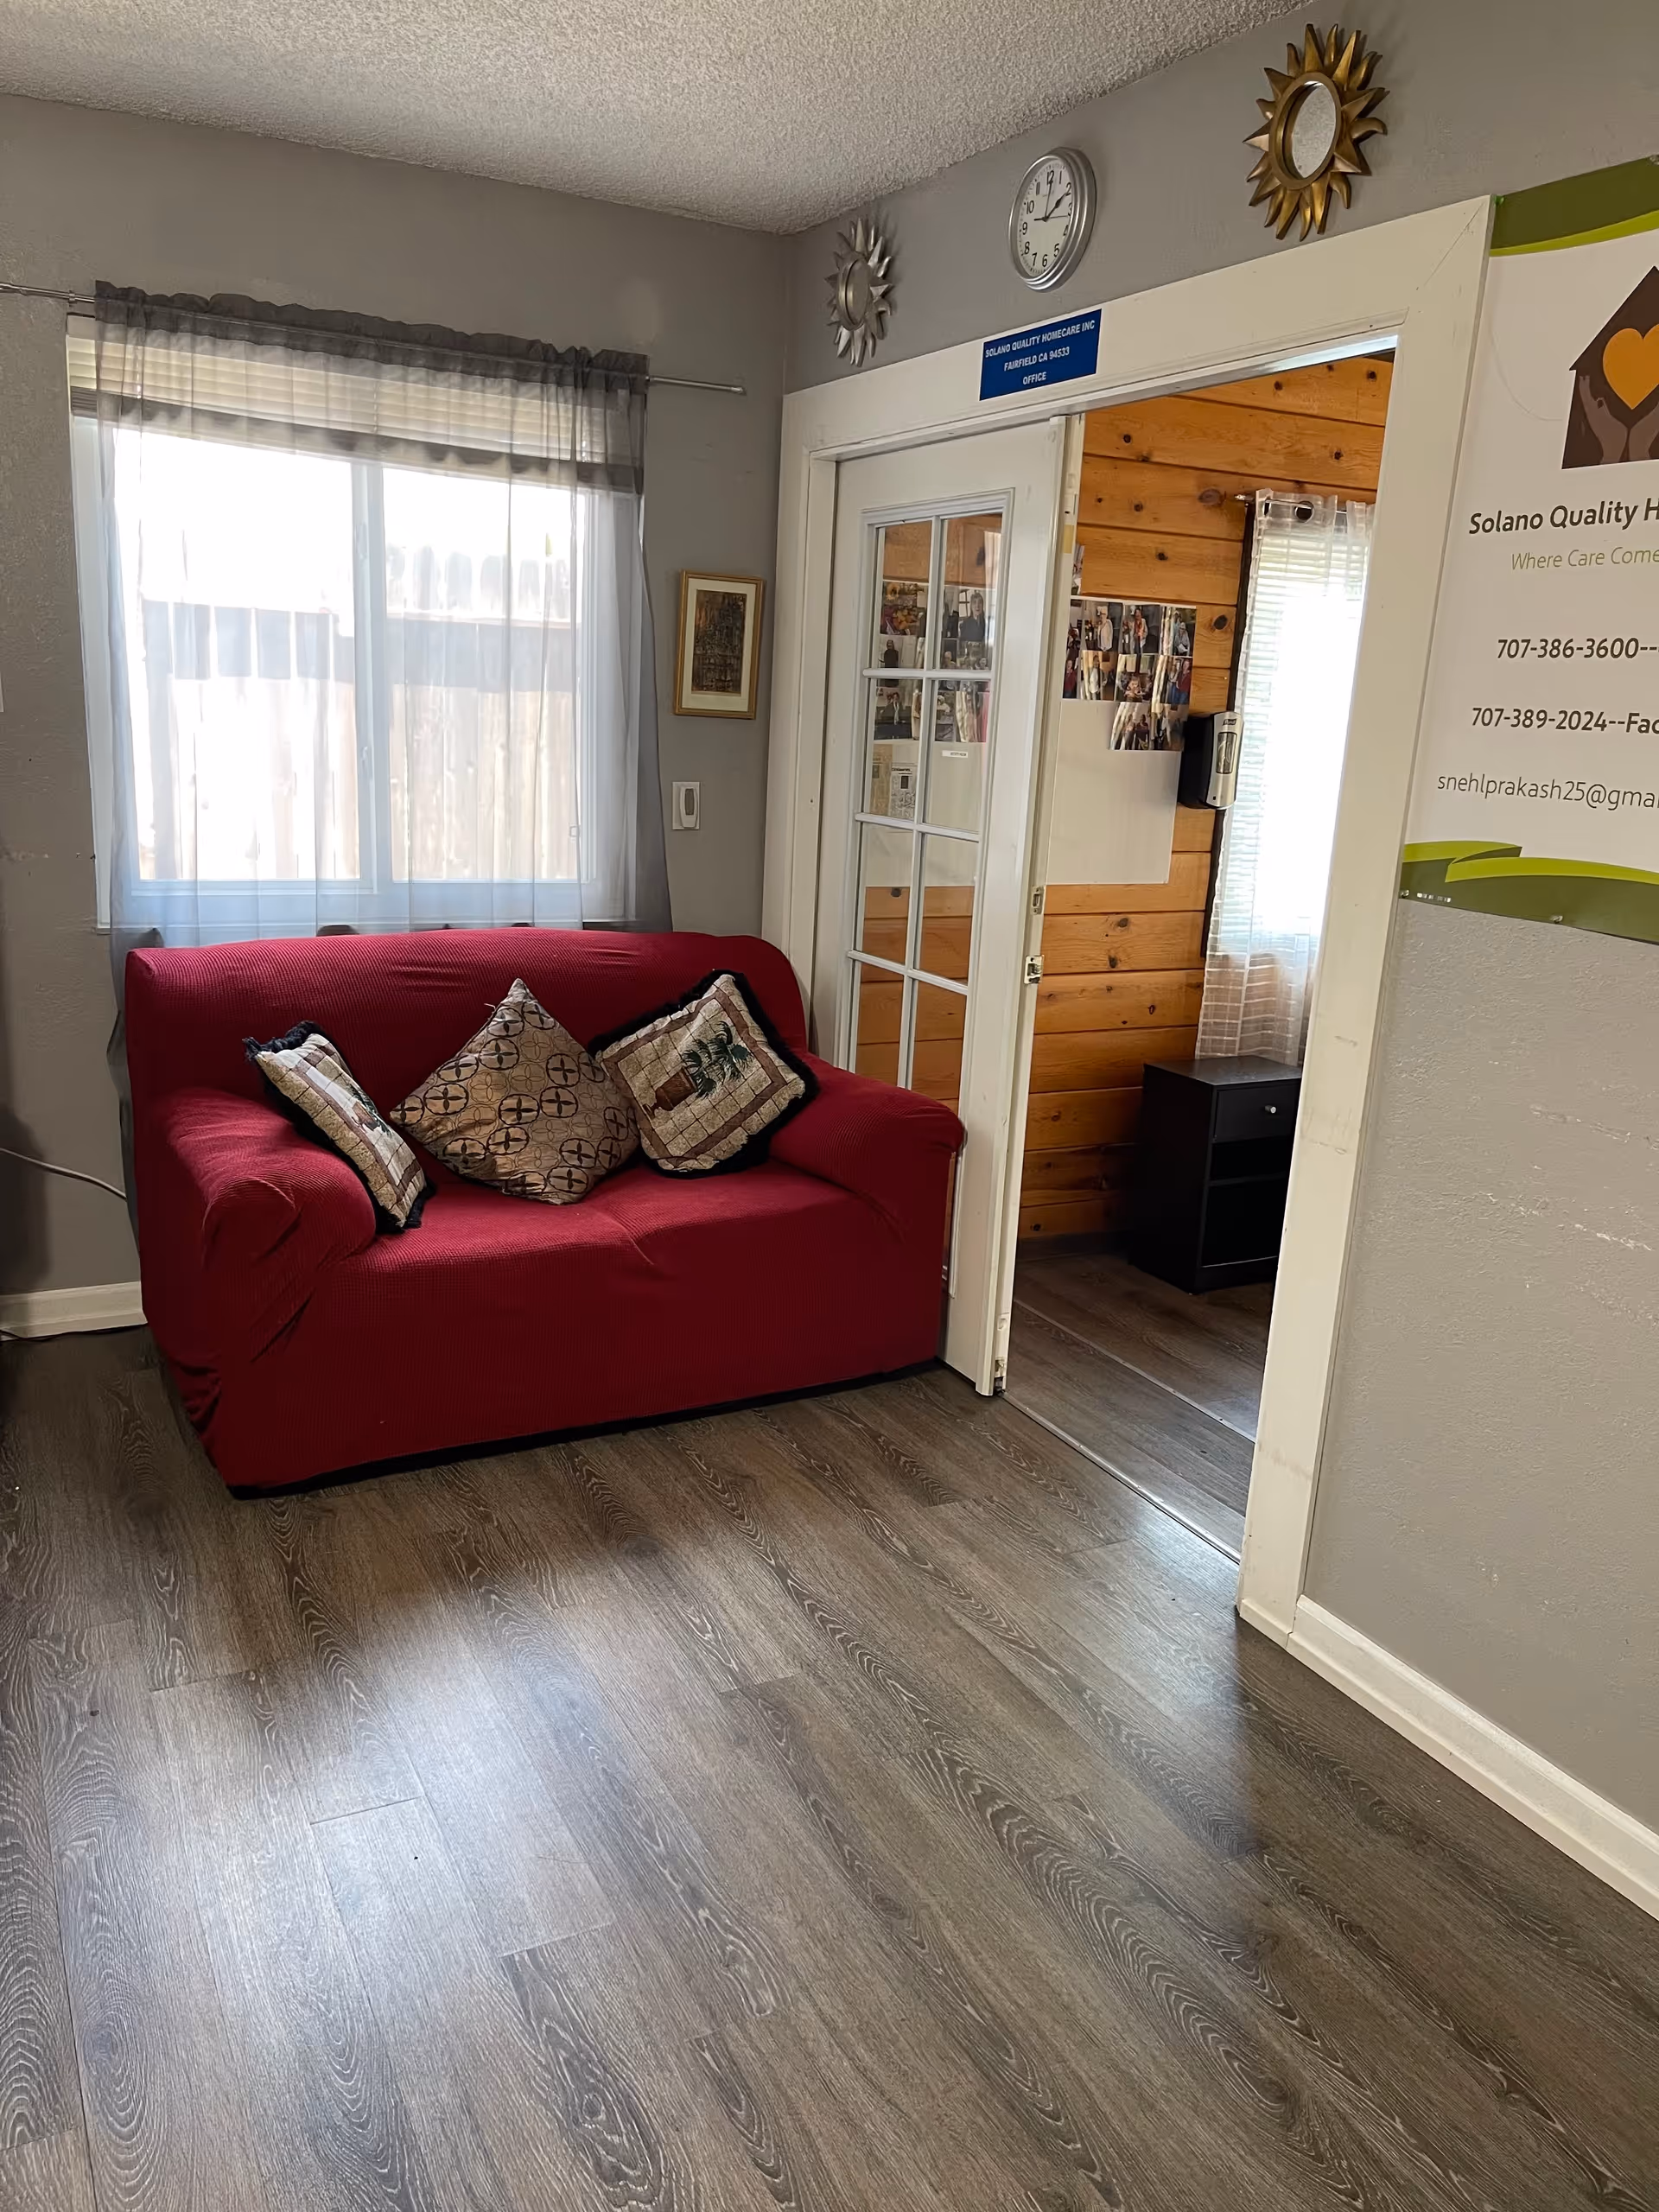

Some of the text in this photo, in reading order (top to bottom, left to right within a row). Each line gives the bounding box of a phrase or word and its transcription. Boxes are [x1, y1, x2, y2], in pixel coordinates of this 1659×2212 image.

[1065, 182, 1071, 196] 2
[1026, 200, 1034, 214] 10
[1022, 222, 1027, 235] 9
[1024, 241, 1030, 255] 8
[1053, 243, 1059, 257] 5
[1032, 252, 1038, 266] 7
[1042, 254, 1047, 267] 6
[985, 320, 1095, 358] SOLANO QUALITY HOMECARE INC
[1003, 346, 1070, 372] FAIRFIELD CA 94533
[1022, 372, 1046, 385] OFFICE
[1469, 510, 1543, 535] Solano
[1549, 500, 1638, 531] Quality
[1511, 551, 1562, 570] Where
[1567, 547, 1605, 568] Care
